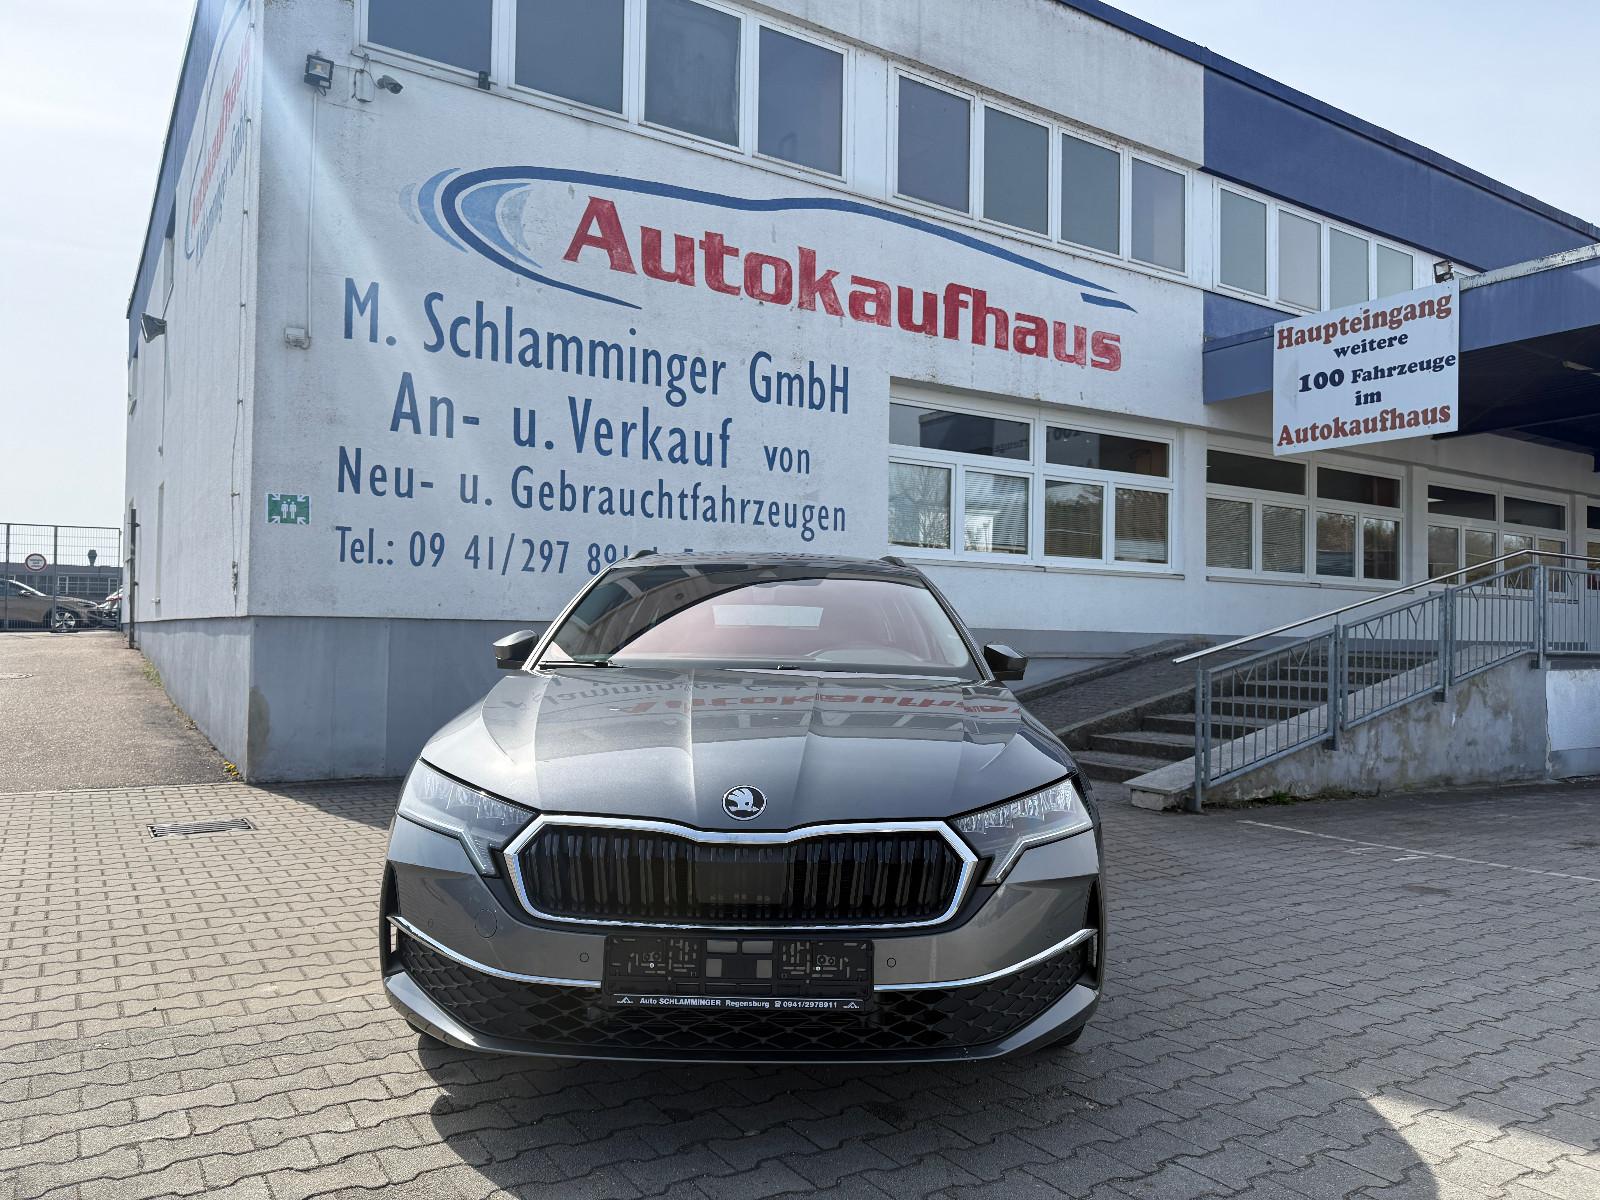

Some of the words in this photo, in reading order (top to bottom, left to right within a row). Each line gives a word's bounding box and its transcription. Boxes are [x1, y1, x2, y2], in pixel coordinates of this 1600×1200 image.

[562, 195, 1123, 373] Autokaufhaus
[343, 277, 397, 346] M.
[423, 291, 727, 408] Schlamminger
[749, 350, 849, 414] GmbH
[1276, 294, 1453, 350] Haupteingang
[1333, 333, 1409, 359] weitere
[1298, 368, 1346, 393] 100
[1350, 354, 1457, 384] Fahrzeuge
[1354, 389, 1383, 406] im
[389, 371, 480, 438] An-
[512, 406, 554, 450] u.
[567, 395, 734, 469] Verkauf
[763, 445, 811, 475] von
[1276, 404, 1452, 447] Autokaufhaus
[336, 446, 434, 499] Neu-
[459, 472, 493, 506] u.
[510, 464, 847, 542] Gebrauchtfahrzeugen
[335, 525, 395, 566] Tel.:
[408, 531, 446, 568] 09
[463, 532, 570, 576] 41/297
[639, 997, 658, 1006] Auto
[658, 997, 722, 1007] SCHLAMMINGER
[725, 999, 770, 1009] Regensburg
[782, 1000, 838, 1009] 0941/2978911
